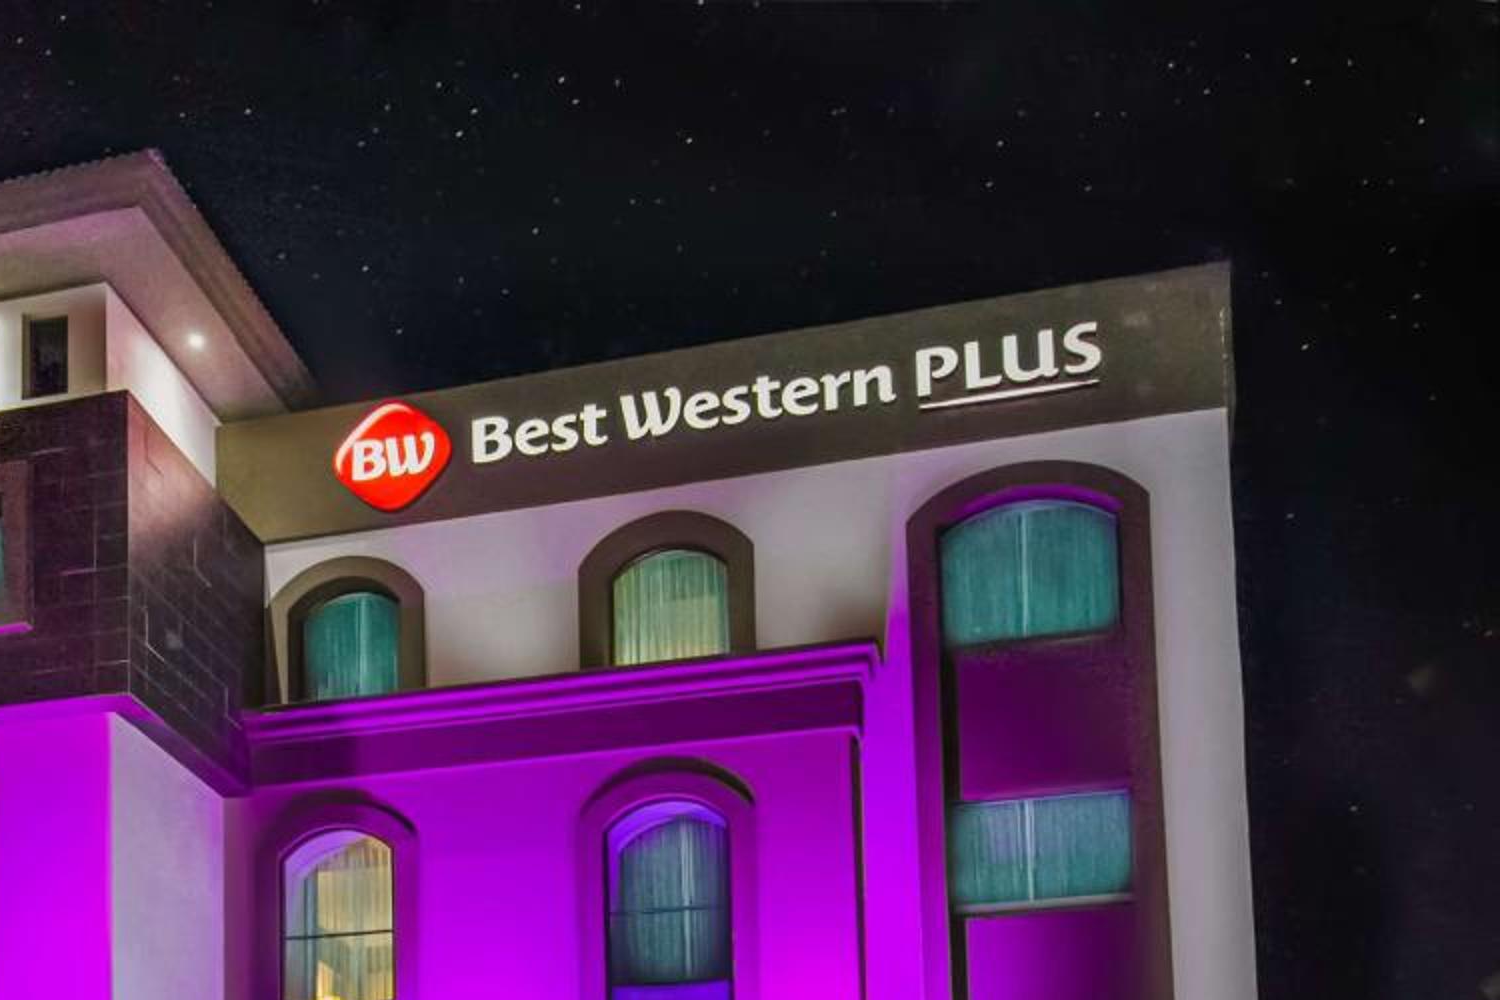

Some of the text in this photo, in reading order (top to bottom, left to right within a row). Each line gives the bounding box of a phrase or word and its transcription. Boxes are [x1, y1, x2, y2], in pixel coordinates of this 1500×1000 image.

[471, 321, 1102, 464] Best Western PLUS
[352, 431, 435, 481] BW
